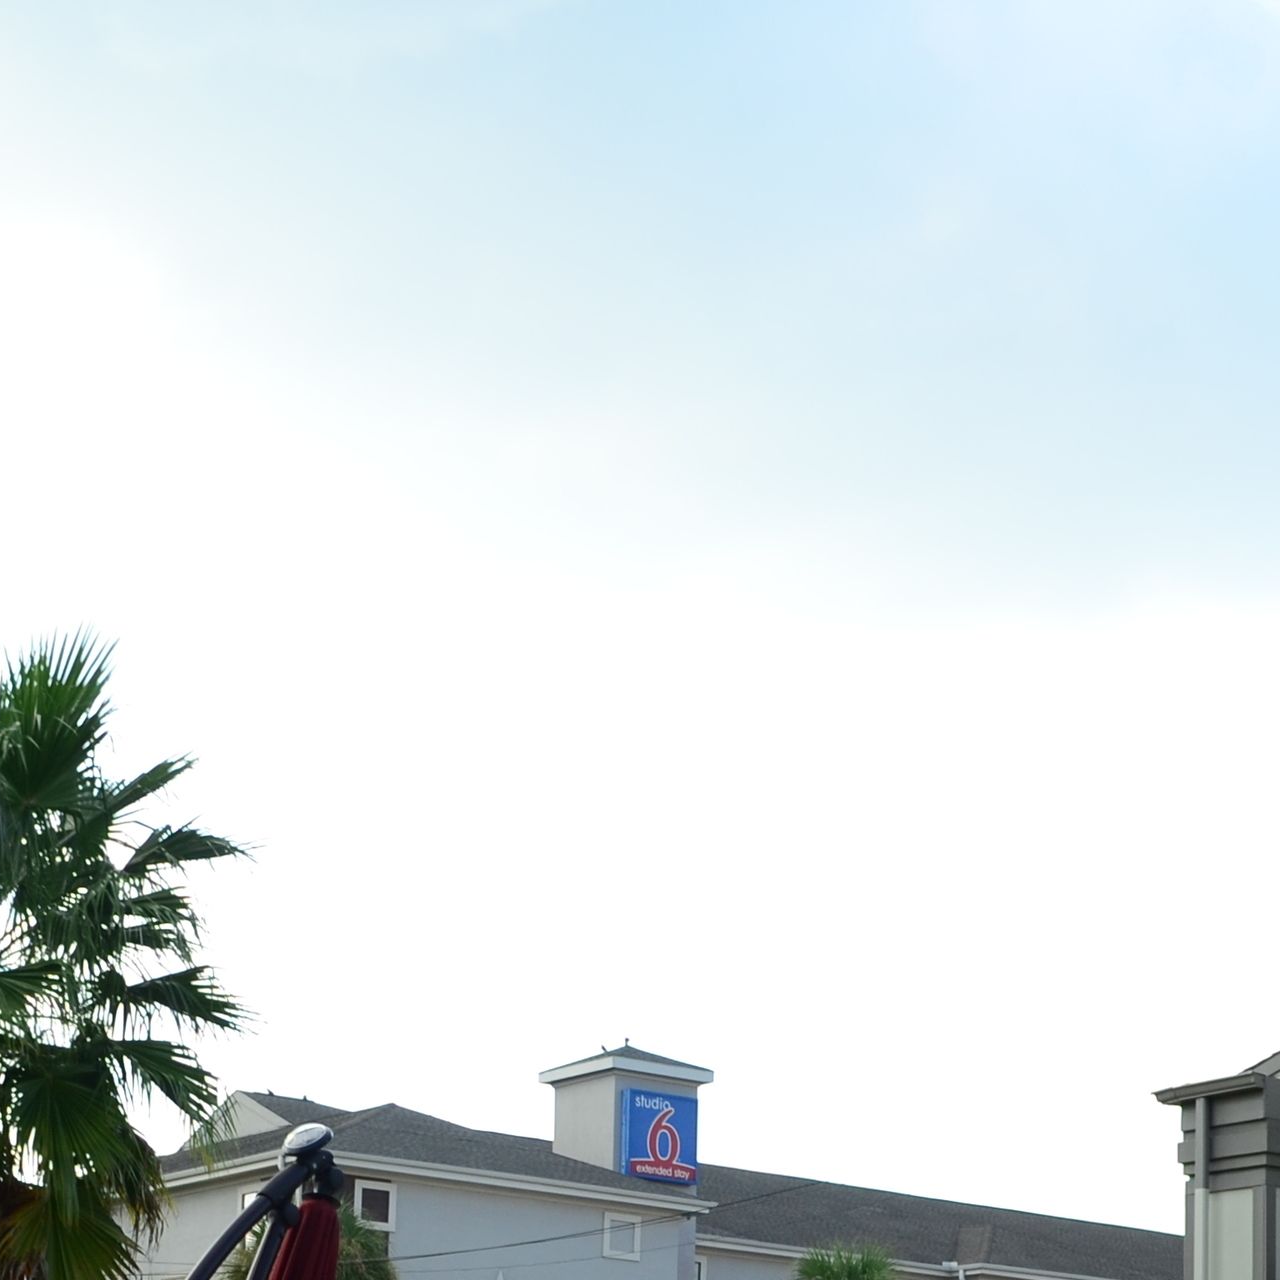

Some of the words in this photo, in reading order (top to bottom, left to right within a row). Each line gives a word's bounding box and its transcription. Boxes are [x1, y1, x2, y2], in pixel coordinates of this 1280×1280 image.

[635, 1095, 672, 1110] studio
[646, 1107, 680, 1162] 6
[636, 1164, 673, 1177] extended
[674, 1169, 690, 1181] stay
